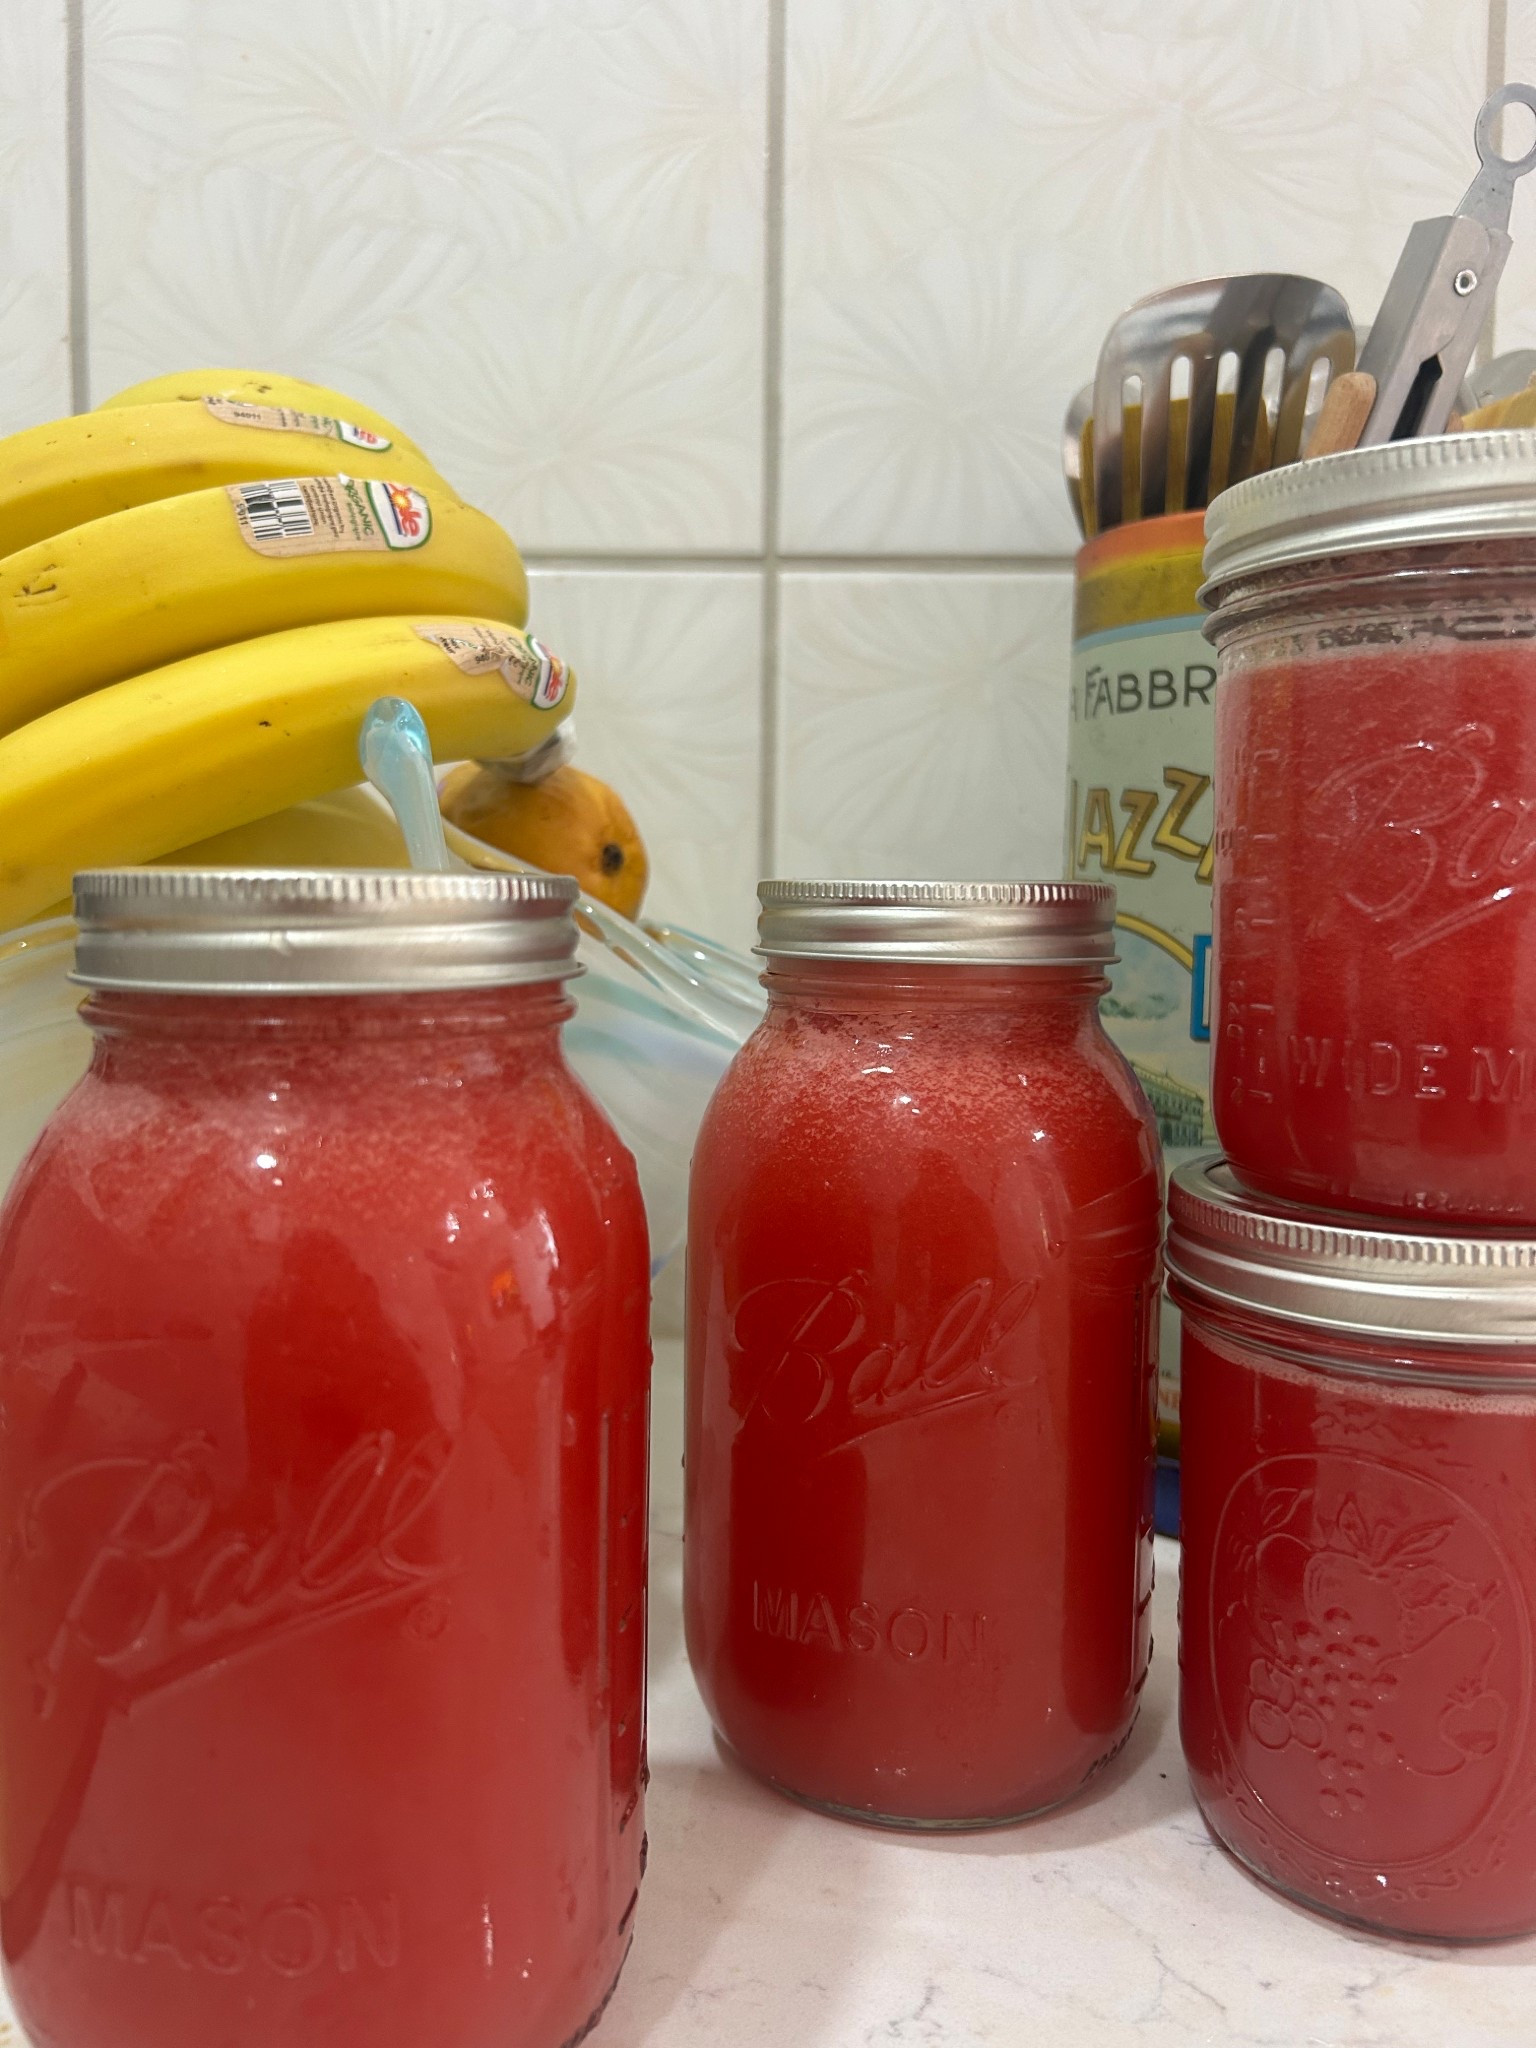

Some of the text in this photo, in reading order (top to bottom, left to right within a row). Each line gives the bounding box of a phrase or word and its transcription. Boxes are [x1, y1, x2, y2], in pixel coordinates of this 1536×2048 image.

[1287, 1035, 1448, 1101] WIDE
[730, 1267, 1042, 1460] Ball
[18, 1430, 465, 1720] Ball
[752, 1579, 988, 1667] MASON
[60, 1879, 401, 1979] MASON
